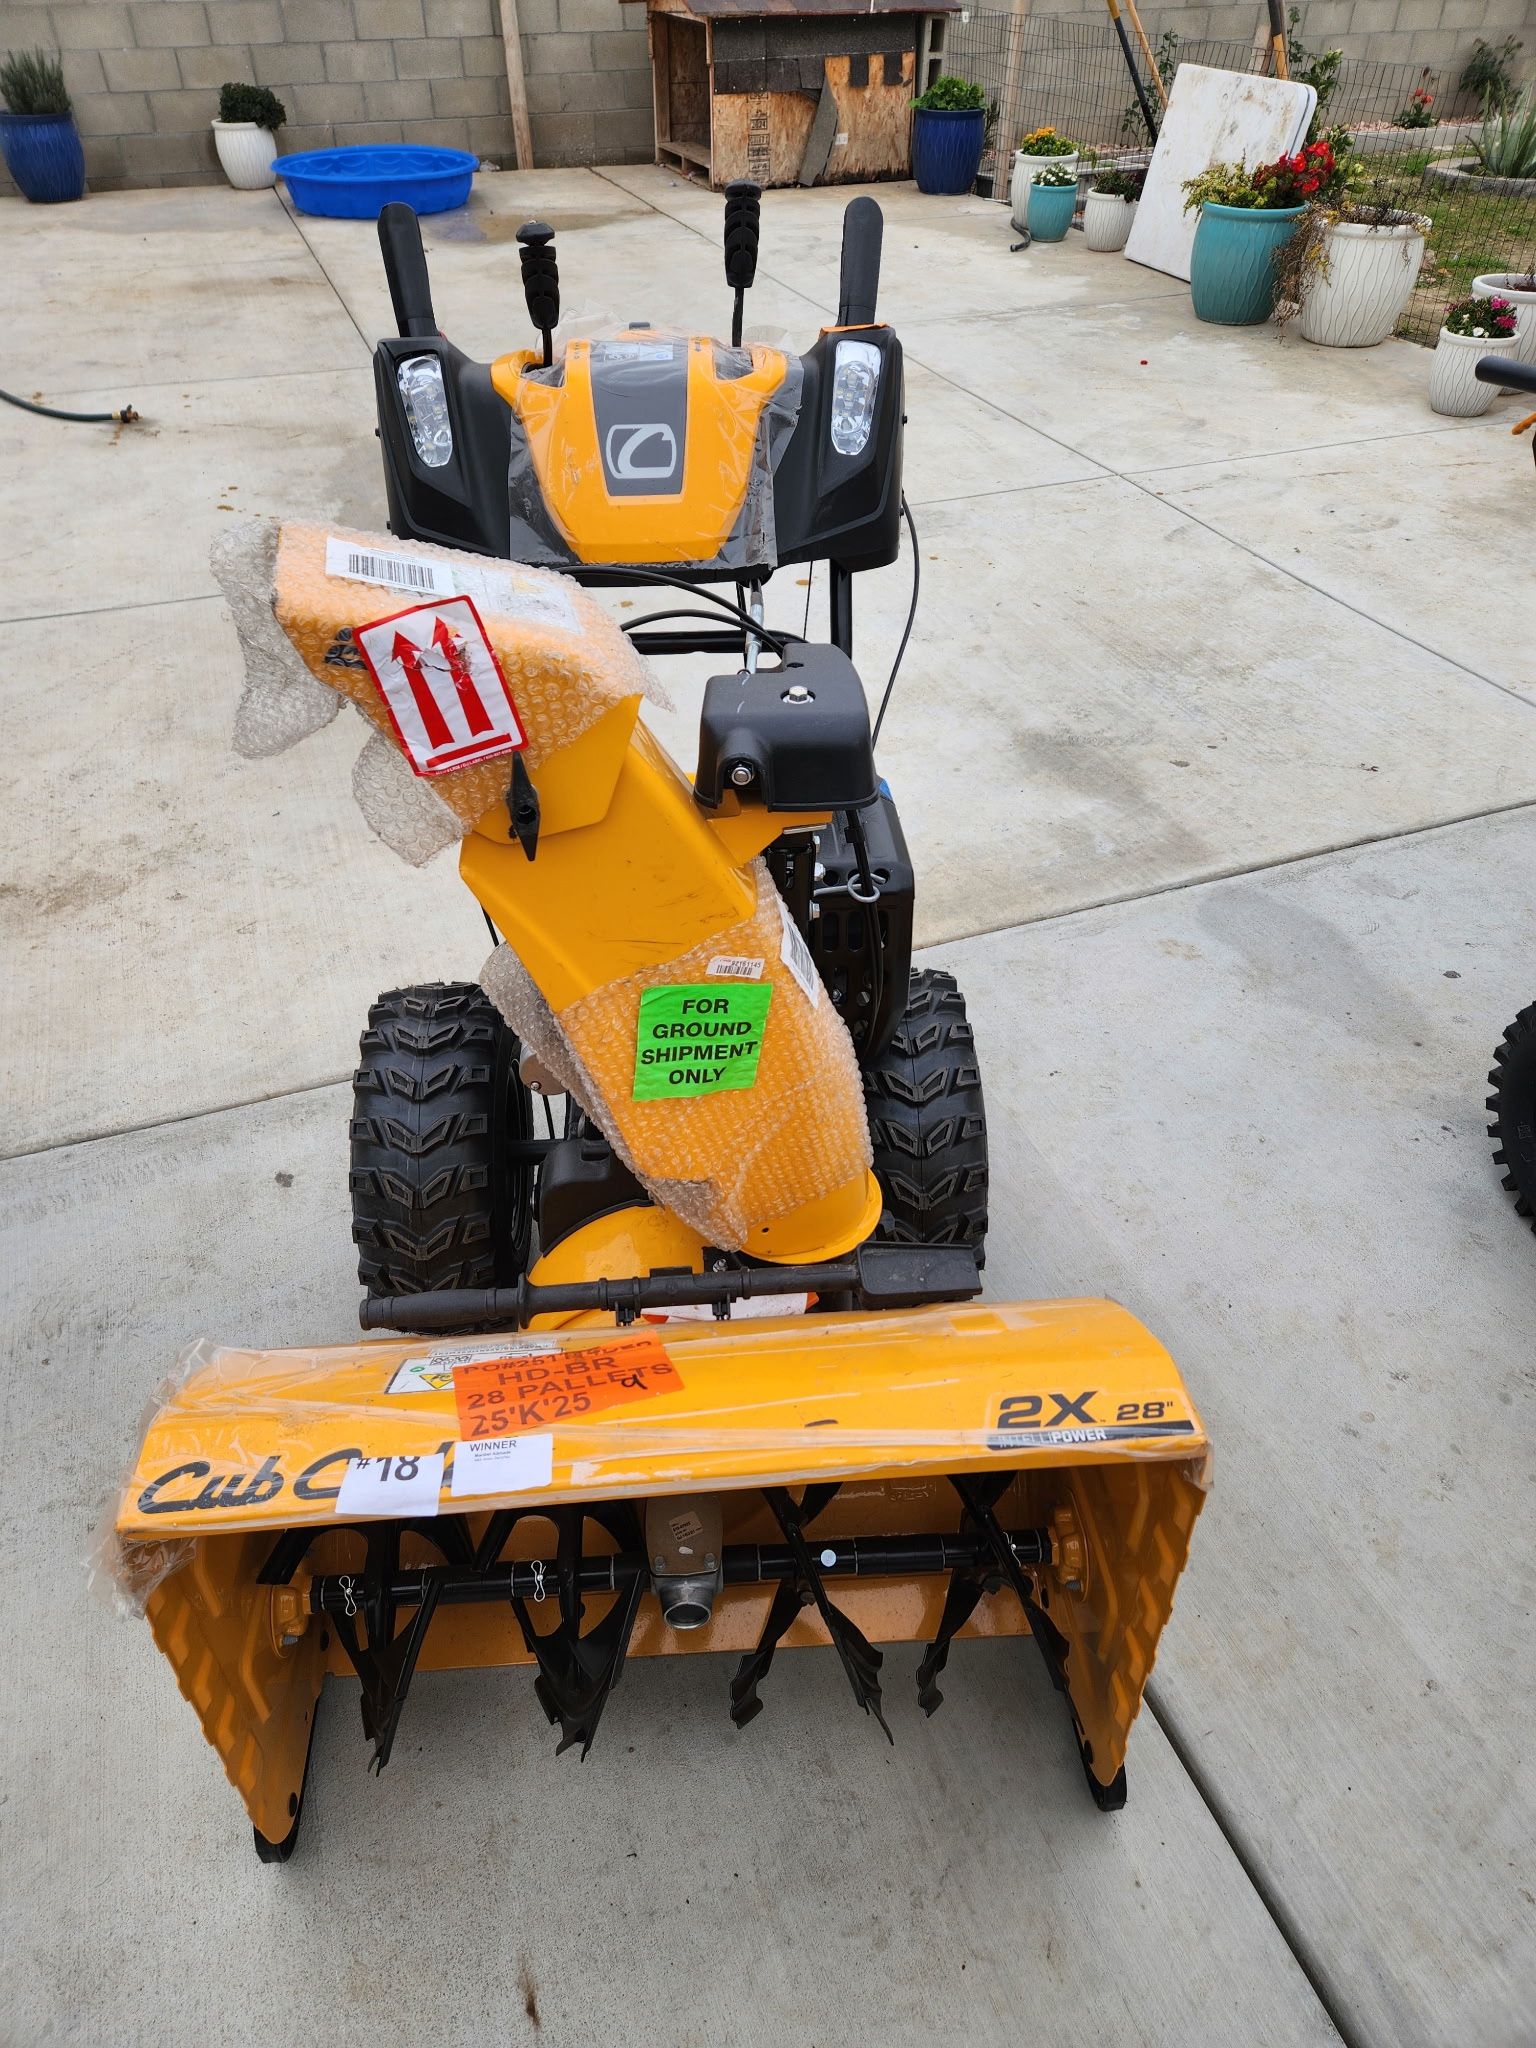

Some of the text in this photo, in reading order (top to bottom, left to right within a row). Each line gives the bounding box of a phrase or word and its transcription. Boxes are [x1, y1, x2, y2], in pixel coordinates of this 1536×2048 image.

[682, 998, 729, 1015] FOR
[652, 1021, 752, 1039] GROUND
[641, 1041, 758, 1065] SHIPMENT
[668, 1066, 728, 1085] ONLY
[499, 1356, 620, 1386] HD-BR
[467, 1362, 673, 1411] 28 PALLETS
[998, 1390, 1174, 1429] 2X 28"
[469, 1439, 517, 1452] WINNER
[137, 1455, 285, 1515] Cub
